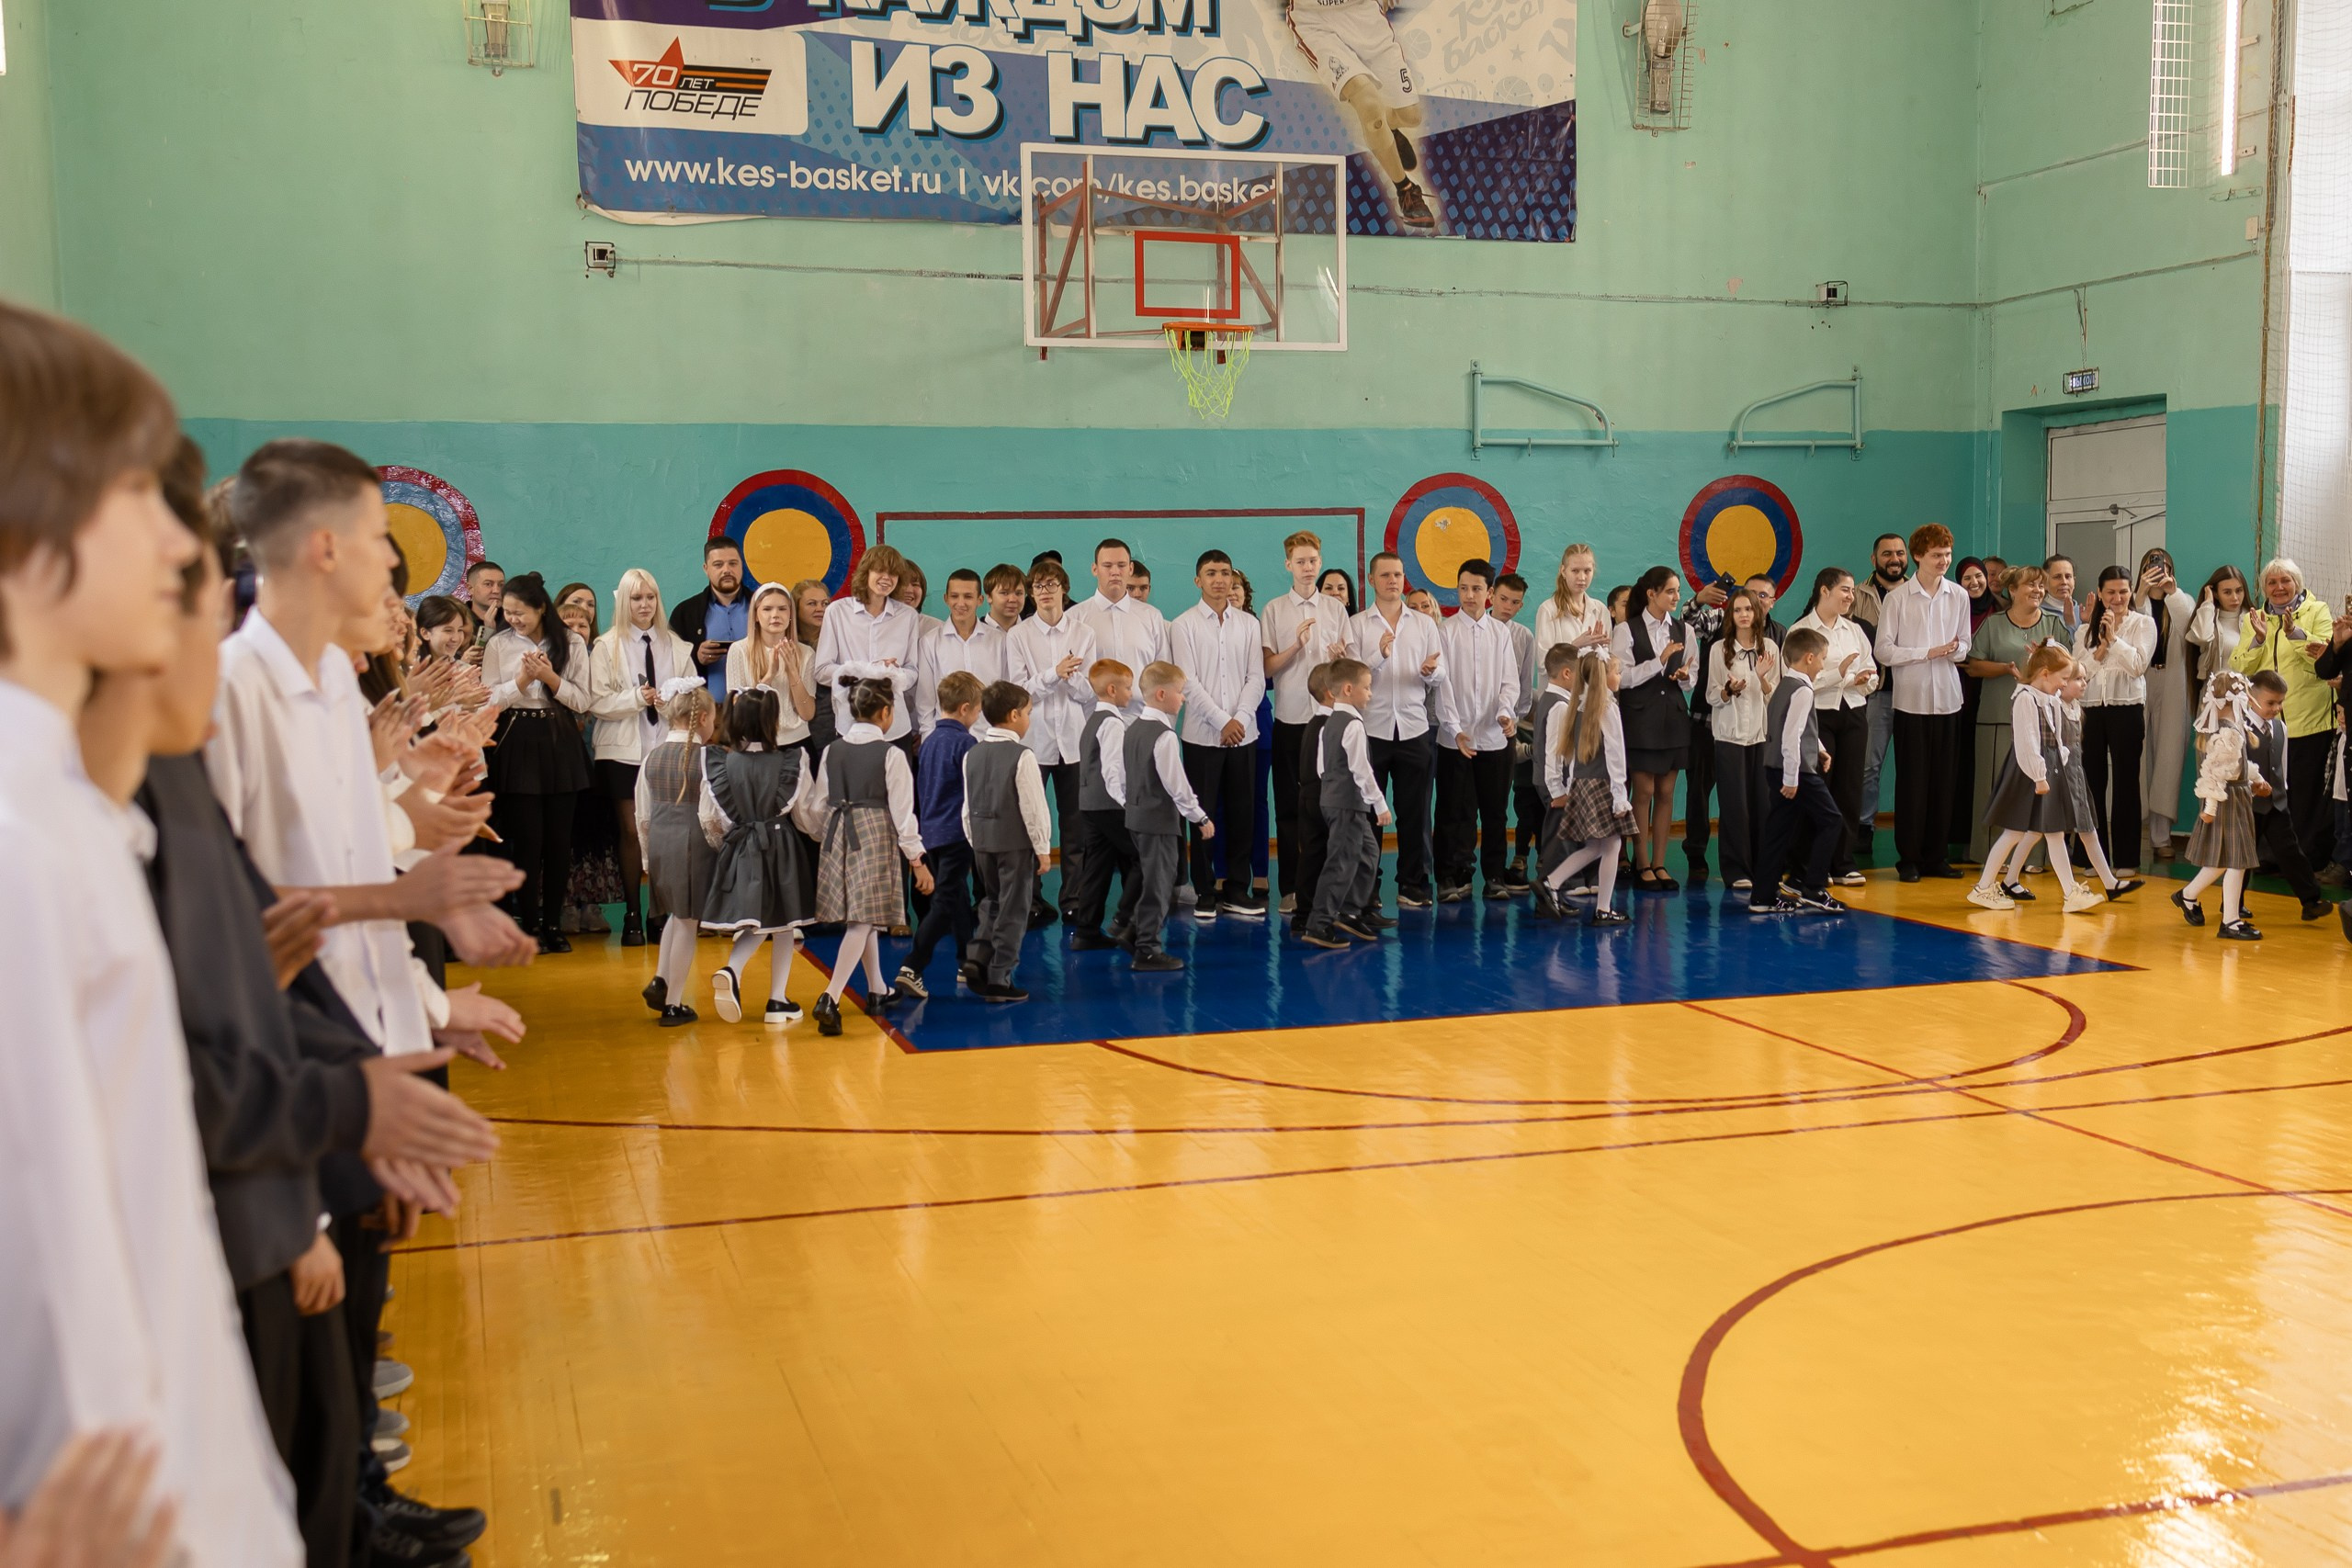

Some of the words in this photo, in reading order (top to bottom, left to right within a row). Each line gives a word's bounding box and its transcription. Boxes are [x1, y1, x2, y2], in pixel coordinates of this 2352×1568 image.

[632, 63, 678, 86] 70
[679, 77, 715, 90] ЛЕТ
[1399, 68, 1413, 94] 5
[624, 89, 763, 121] ПОБЕДЕ
[850, 39, 1001, 138] ИЗ
[1046, 51, 1268, 147] НАС
[624, 156, 942, 195] www.kes-basket.ru
